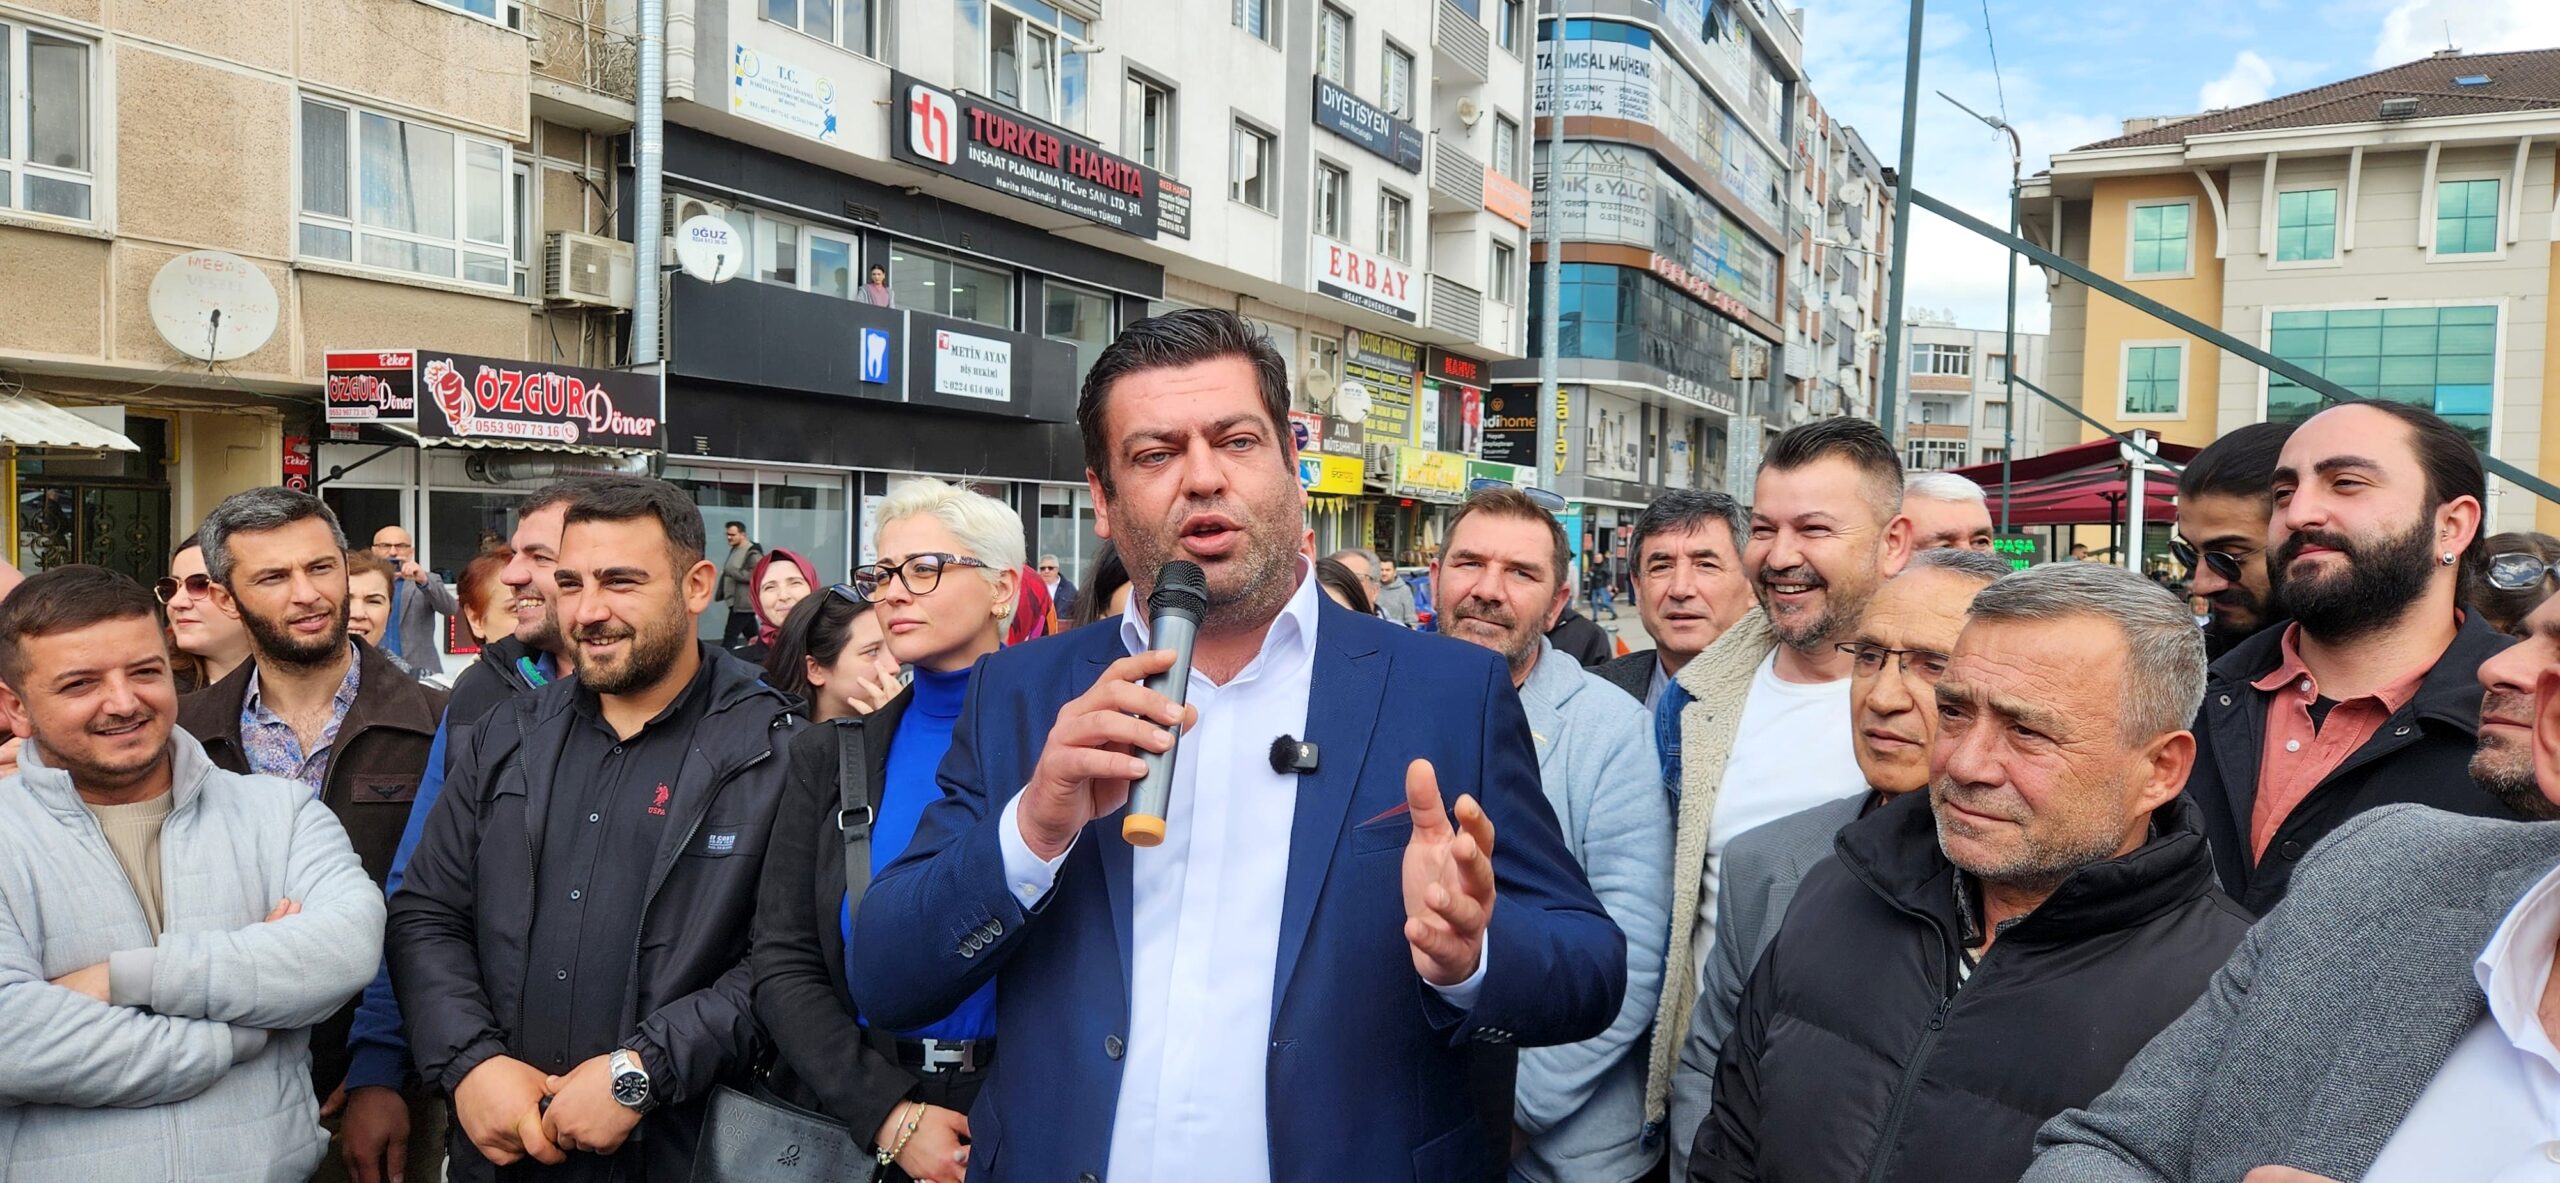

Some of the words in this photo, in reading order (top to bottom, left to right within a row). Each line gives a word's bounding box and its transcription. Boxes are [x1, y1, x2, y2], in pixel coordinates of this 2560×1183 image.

[1536, 52, 1605, 70] TAIMSAL
[777, 65, 798, 84] T.C.
[1590, 100, 1603, 111] 34
[968, 105, 1060, 168] TÜRKER
[969, 143, 1006, 171] İNŞAAT
[1008, 160, 1061, 190] PLANLAMA
[1110, 195, 1127, 211] LTD.
[1594, 183, 1604, 194] &
[996, 176, 1020, 193] Harita
[1020, 185, 1057, 205] Mühendisi
[1061, 199, 1098, 218] Hüsamettin
[1098, 209, 1122, 226] TÜRKER
[692, 227, 727, 240] OĞUZ
[1329, 245, 1409, 301] ERBAY
[1360, 331, 1381, 354] LOTUS
[951, 345, 981, 360] METİN
[984, 350, 1008, 364] AYAN
[973, 367, 998, 379] HEKİMİ
[1444, 356, 1477, 380] KAHVE
[329, 374, 380, 403] ÖZGÜR
[378, 378, 414, 411] Döner
[949, 380, 968, 392] 0224
[474, 364, 587, 420] ÖZGÜR
[584, 381, 657, 437] Döner
[475, 419, 504, 434] 0553
[507, 421, 527, 436] 907
[531, 423, 544, 437] 73
[547, 424, 560, 438] 16
[1334, 423, 1350, 438] ATA
[1555, 387, 1569, 477] saray
[1993, 538, 2036, 556] PAŞA
[721, 1103, 768, 1130] UNITED
